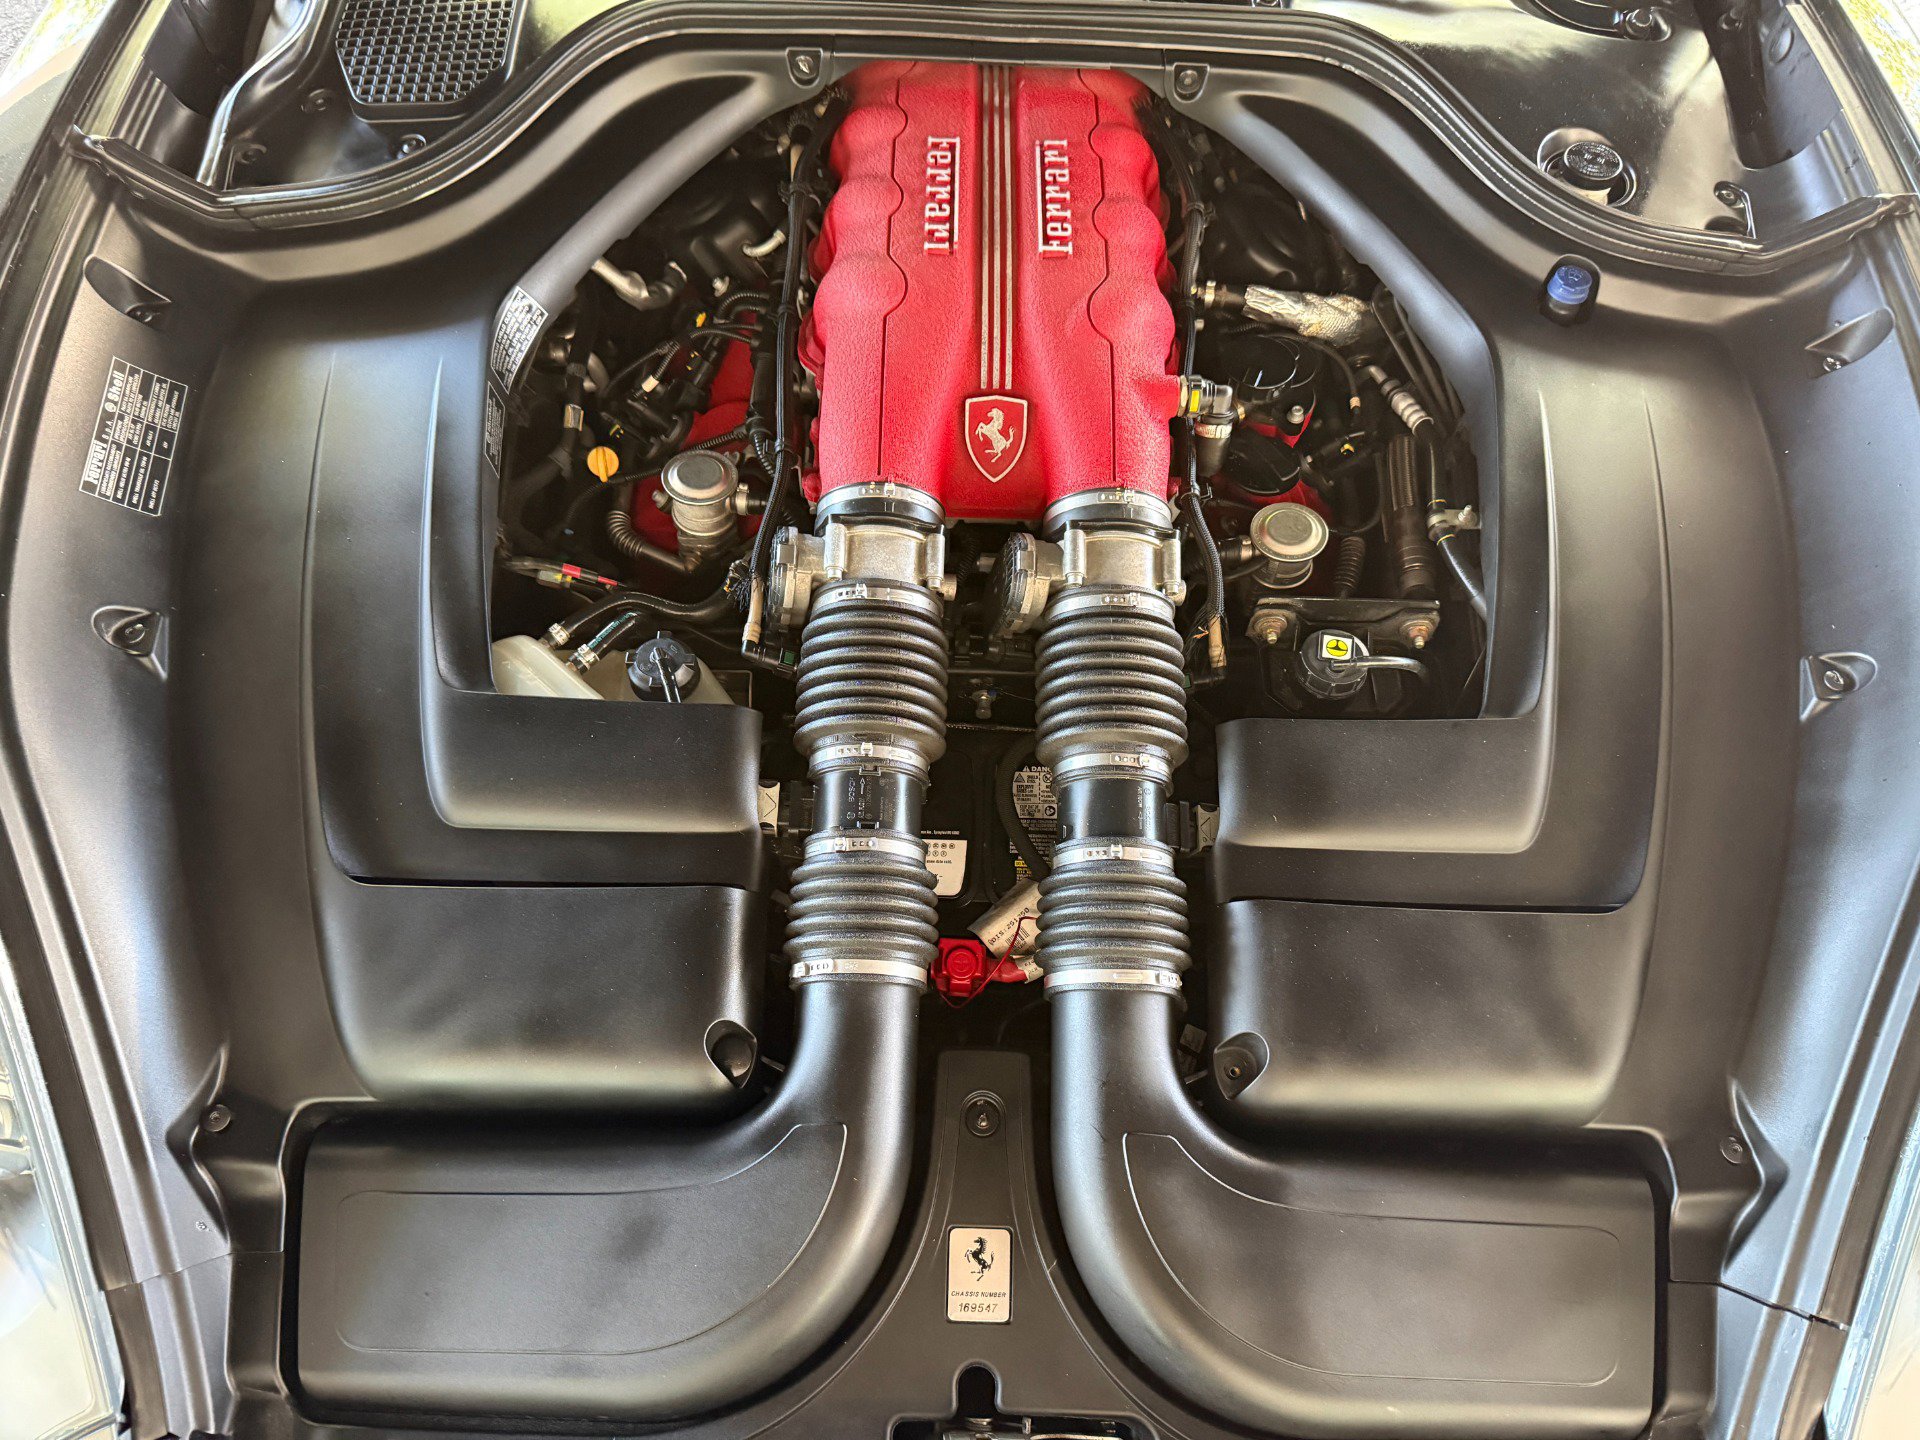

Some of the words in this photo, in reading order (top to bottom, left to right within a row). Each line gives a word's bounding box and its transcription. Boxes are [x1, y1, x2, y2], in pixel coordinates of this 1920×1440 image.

[923, 136, 960, 252] Ferrari
[1036, 139, 1073, 254] Ferrari
[84, 440, 107, 484] Ferrari
[110, 371, 124, 402] Shell
[958, 1303, 998, 1312] 169547
